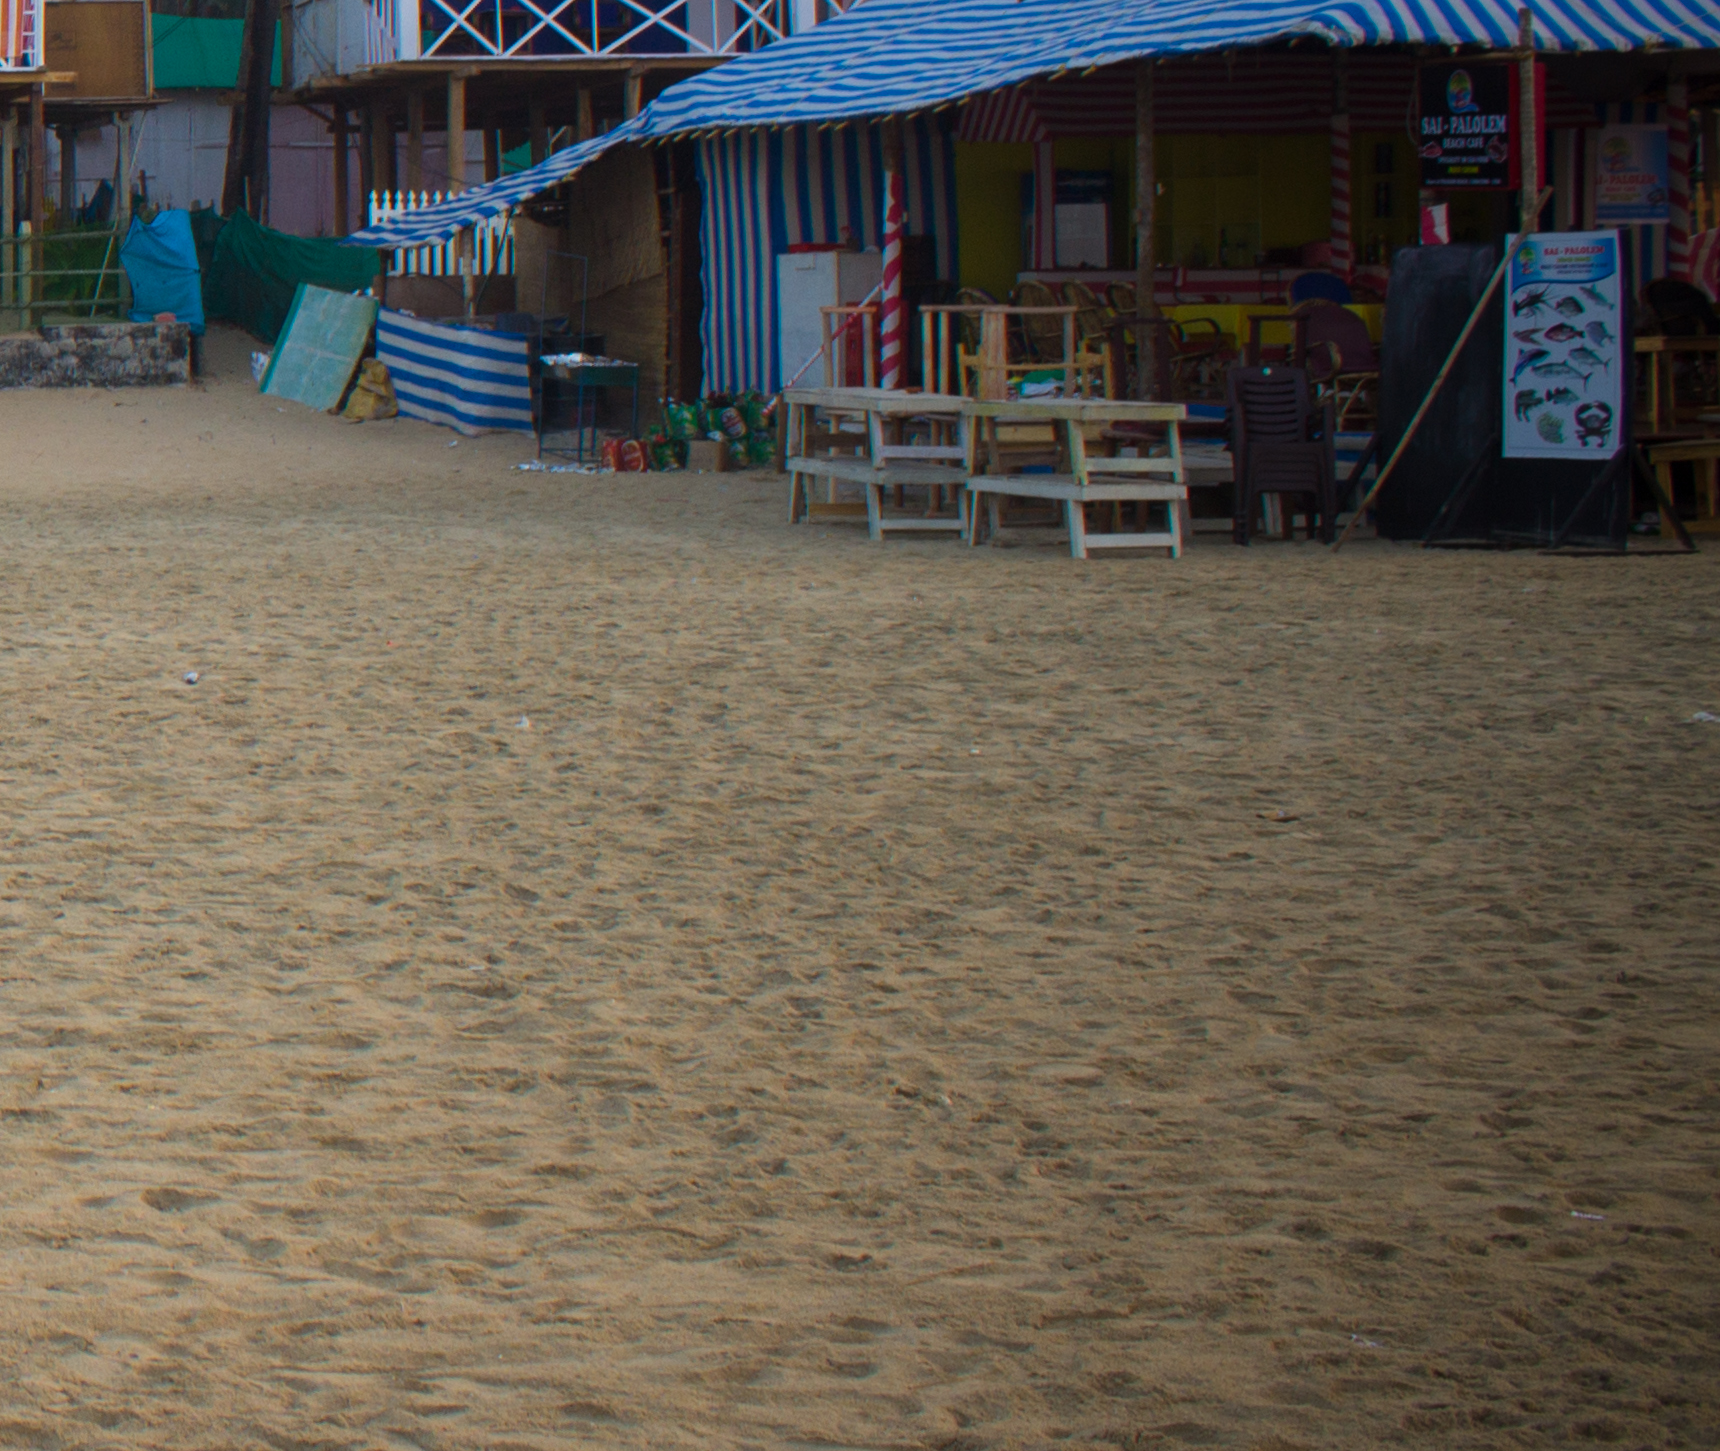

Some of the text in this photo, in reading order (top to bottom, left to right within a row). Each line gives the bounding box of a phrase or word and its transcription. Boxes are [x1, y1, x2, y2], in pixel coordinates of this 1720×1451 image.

[1421, 116, 1444, 135] SAI
[1449, 114, 1507, 135] PALOLEM
[1442, 137, 1466, 149] BEACH
[1609, 174, 1657, 185] PALOLEM
[1544, 247, 1559, 256] SAI
[1564, 245, 1606, 255] PALOLEM
